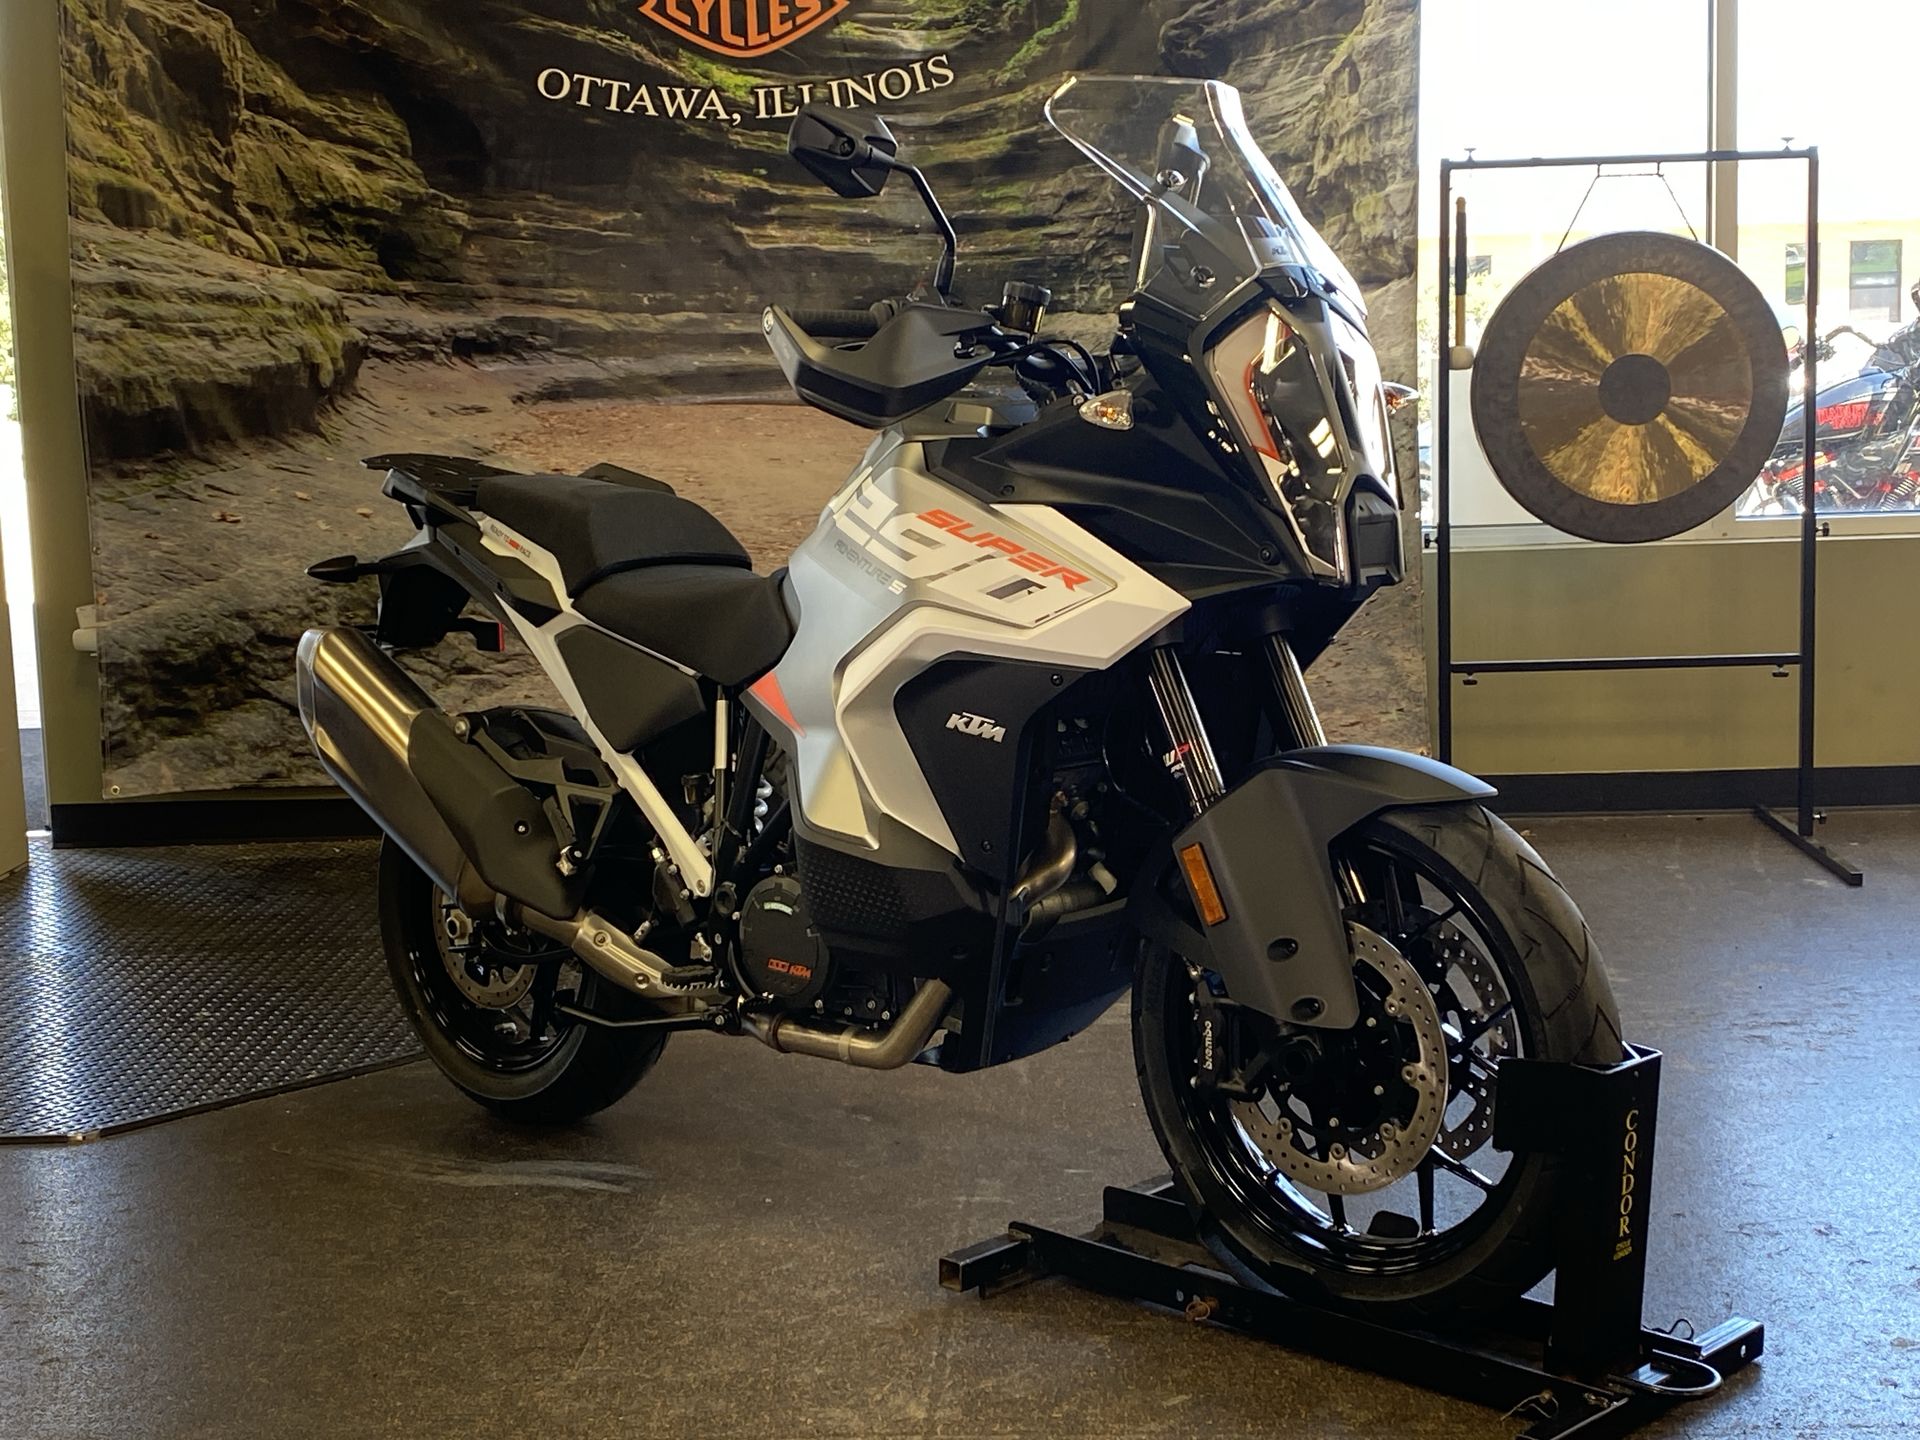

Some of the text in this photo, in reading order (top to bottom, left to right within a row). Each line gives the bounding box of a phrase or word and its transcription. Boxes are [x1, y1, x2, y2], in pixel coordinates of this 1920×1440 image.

[537, 67, 742, 126] OTTAWA,
[834, 539, 909, 596] ADVENTURE S
[916, 508, 1091, 592] SUPER
[945, 711, 1007, 744] KTM
[1202, 1020, 1213, 1071] brembo
[1619, 1109, 1639, 1237] CONDOR
